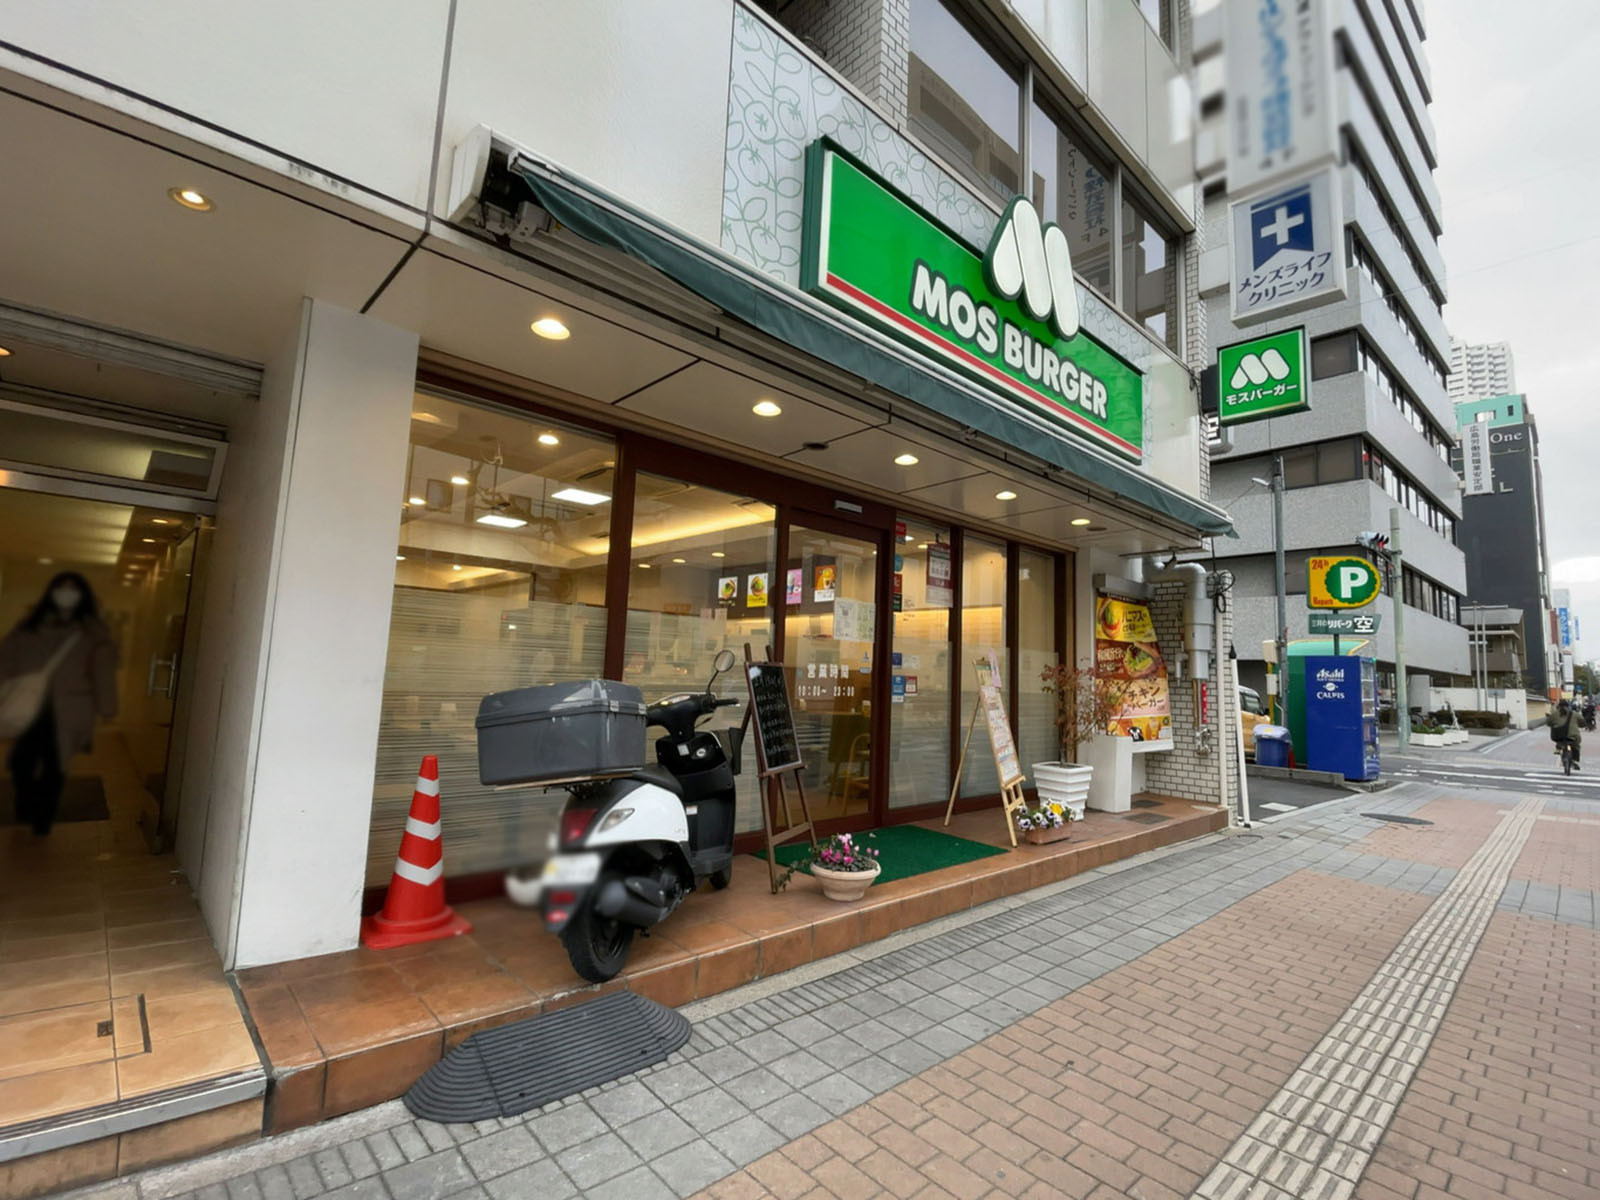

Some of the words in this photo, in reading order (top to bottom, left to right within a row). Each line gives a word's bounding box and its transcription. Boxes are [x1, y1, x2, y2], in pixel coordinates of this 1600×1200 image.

[1239, 252, 1332, 294] メンズライフ
[1248, 272, 1325, 306] クリニック
[912, 263, 998, 354] MOS
[1004, 323, 1107, 420] BURGER
[1226, 383, 1298, 406] モスバーガー
[1490, 432, 1523, 444] One
[1339, 566, 1369, 599] P
[1353, 615, 1375, 633] 空
